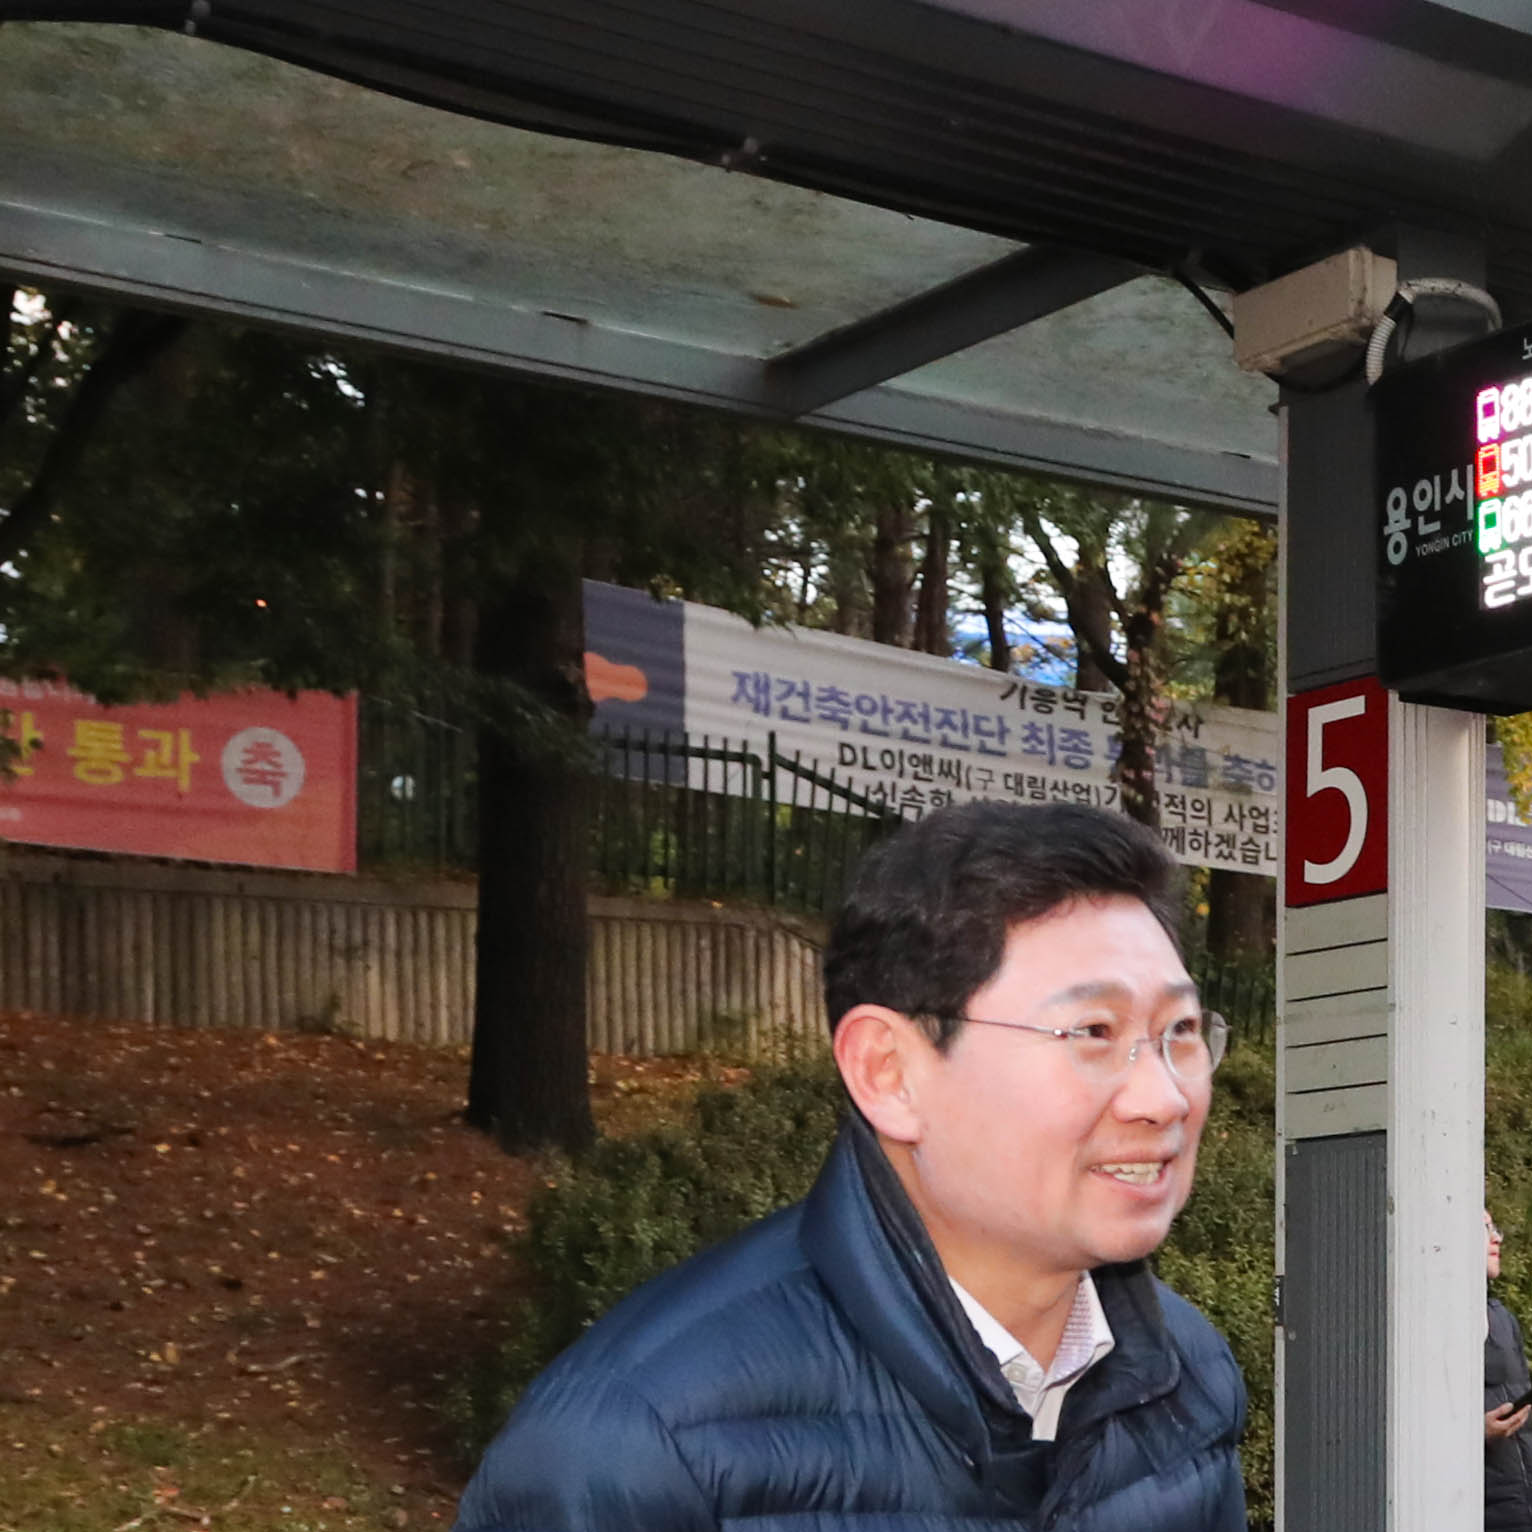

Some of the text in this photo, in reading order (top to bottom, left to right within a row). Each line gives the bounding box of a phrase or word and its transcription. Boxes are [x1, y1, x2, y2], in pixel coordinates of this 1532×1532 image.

[1383, 463, 1474, 566] 용인시
[1415, 529, 1473, 558] YONGIN CITY
[66, 718, 201, 793] 통과
[730, 670, 1011, 757] 재건축안전진단
[1020, 719, 1096, 771] 최종
[1222, 802, 1278, 835] 사업
[1304, 694, 1369, 885] 5
